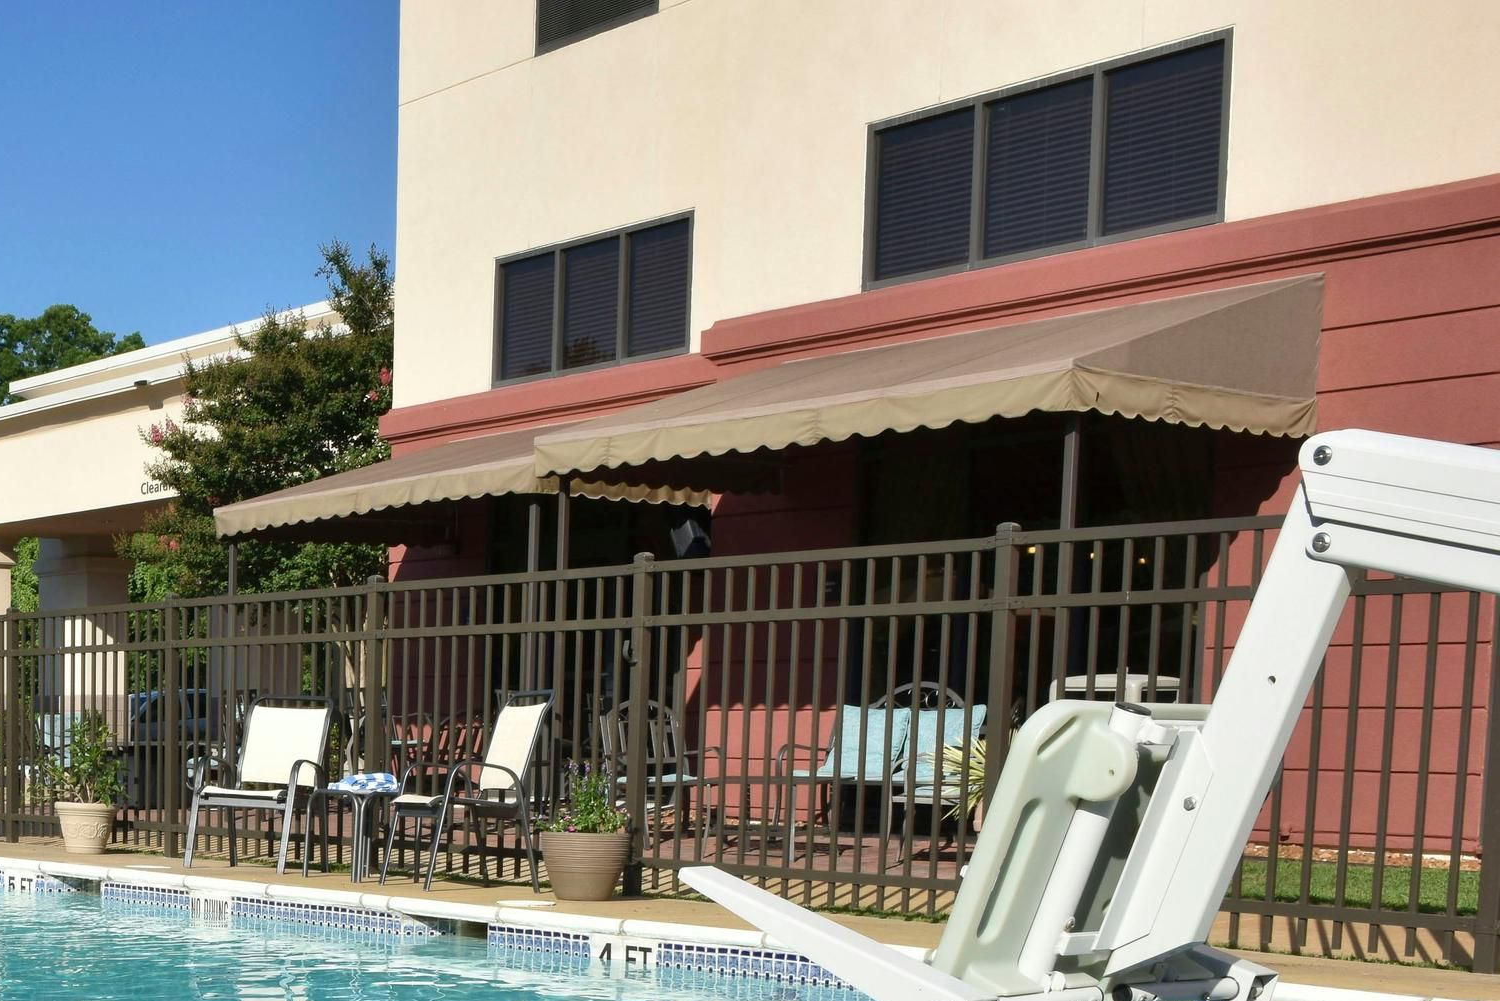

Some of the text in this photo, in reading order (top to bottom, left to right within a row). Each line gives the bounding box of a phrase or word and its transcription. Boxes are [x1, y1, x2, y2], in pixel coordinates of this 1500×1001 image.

[8, 876, 33, 894] 5 FT
[191, 897, 229, 921] NO DIVING
[599, 942, 653, 968] 4 FT
